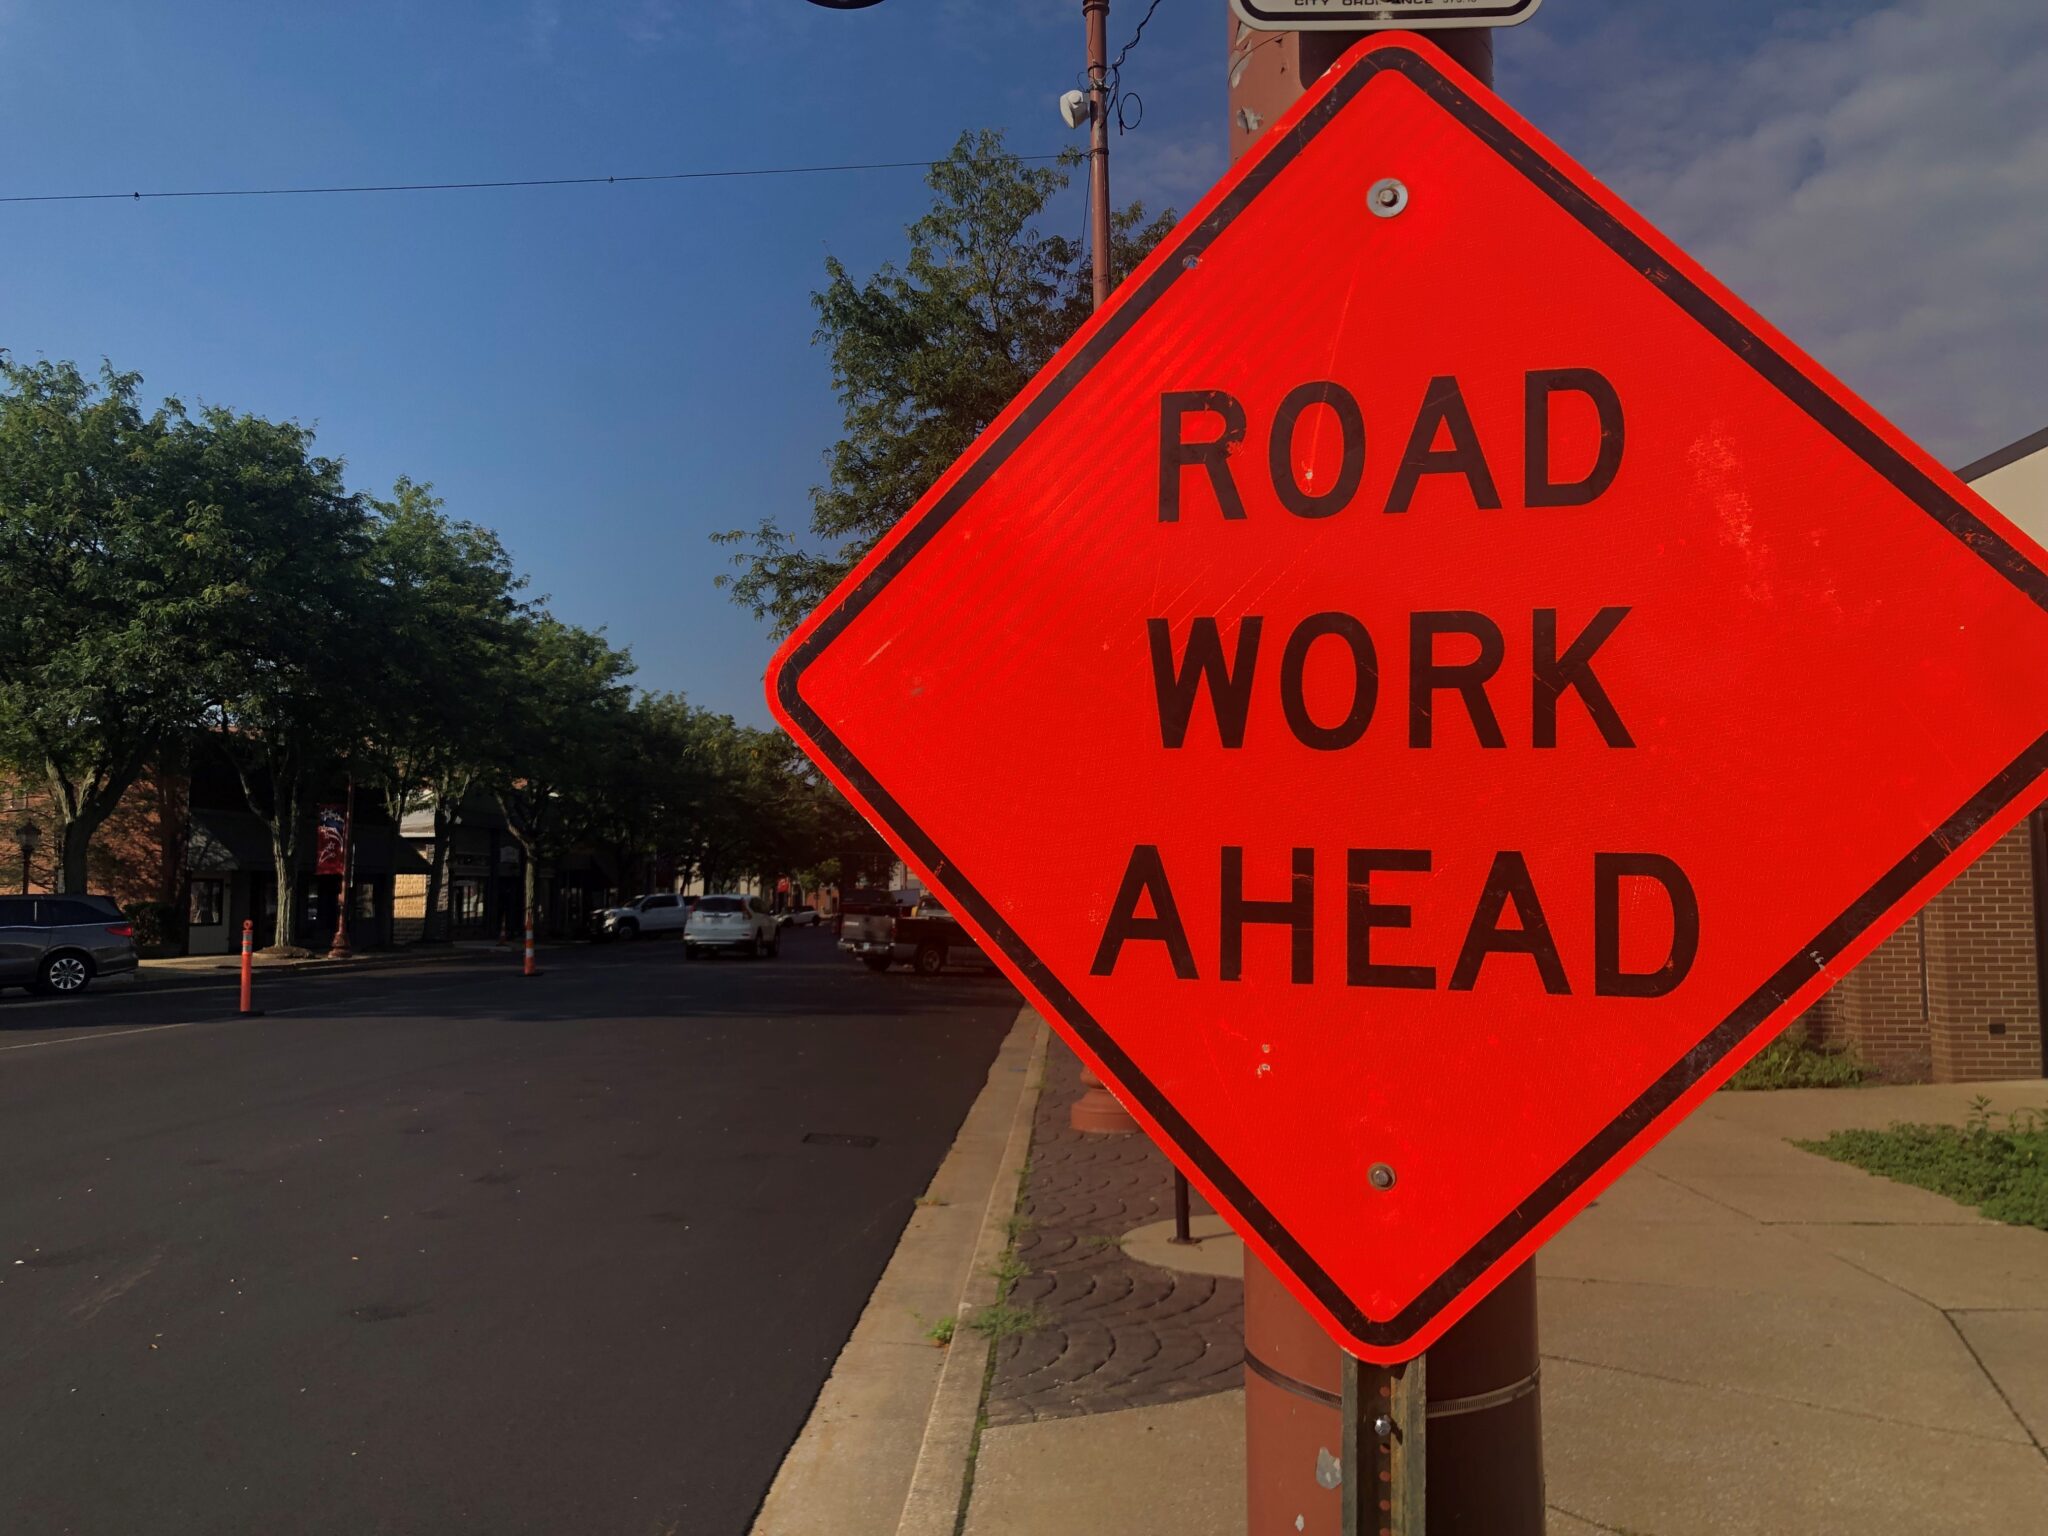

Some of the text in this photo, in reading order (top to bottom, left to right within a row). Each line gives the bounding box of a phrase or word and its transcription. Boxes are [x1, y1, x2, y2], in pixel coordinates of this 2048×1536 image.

[1159, 368, 1625, 523] ROAD
[1148, 606, 1637, 750] WORK
[1089, 844, 1700, 998] AHEAD
